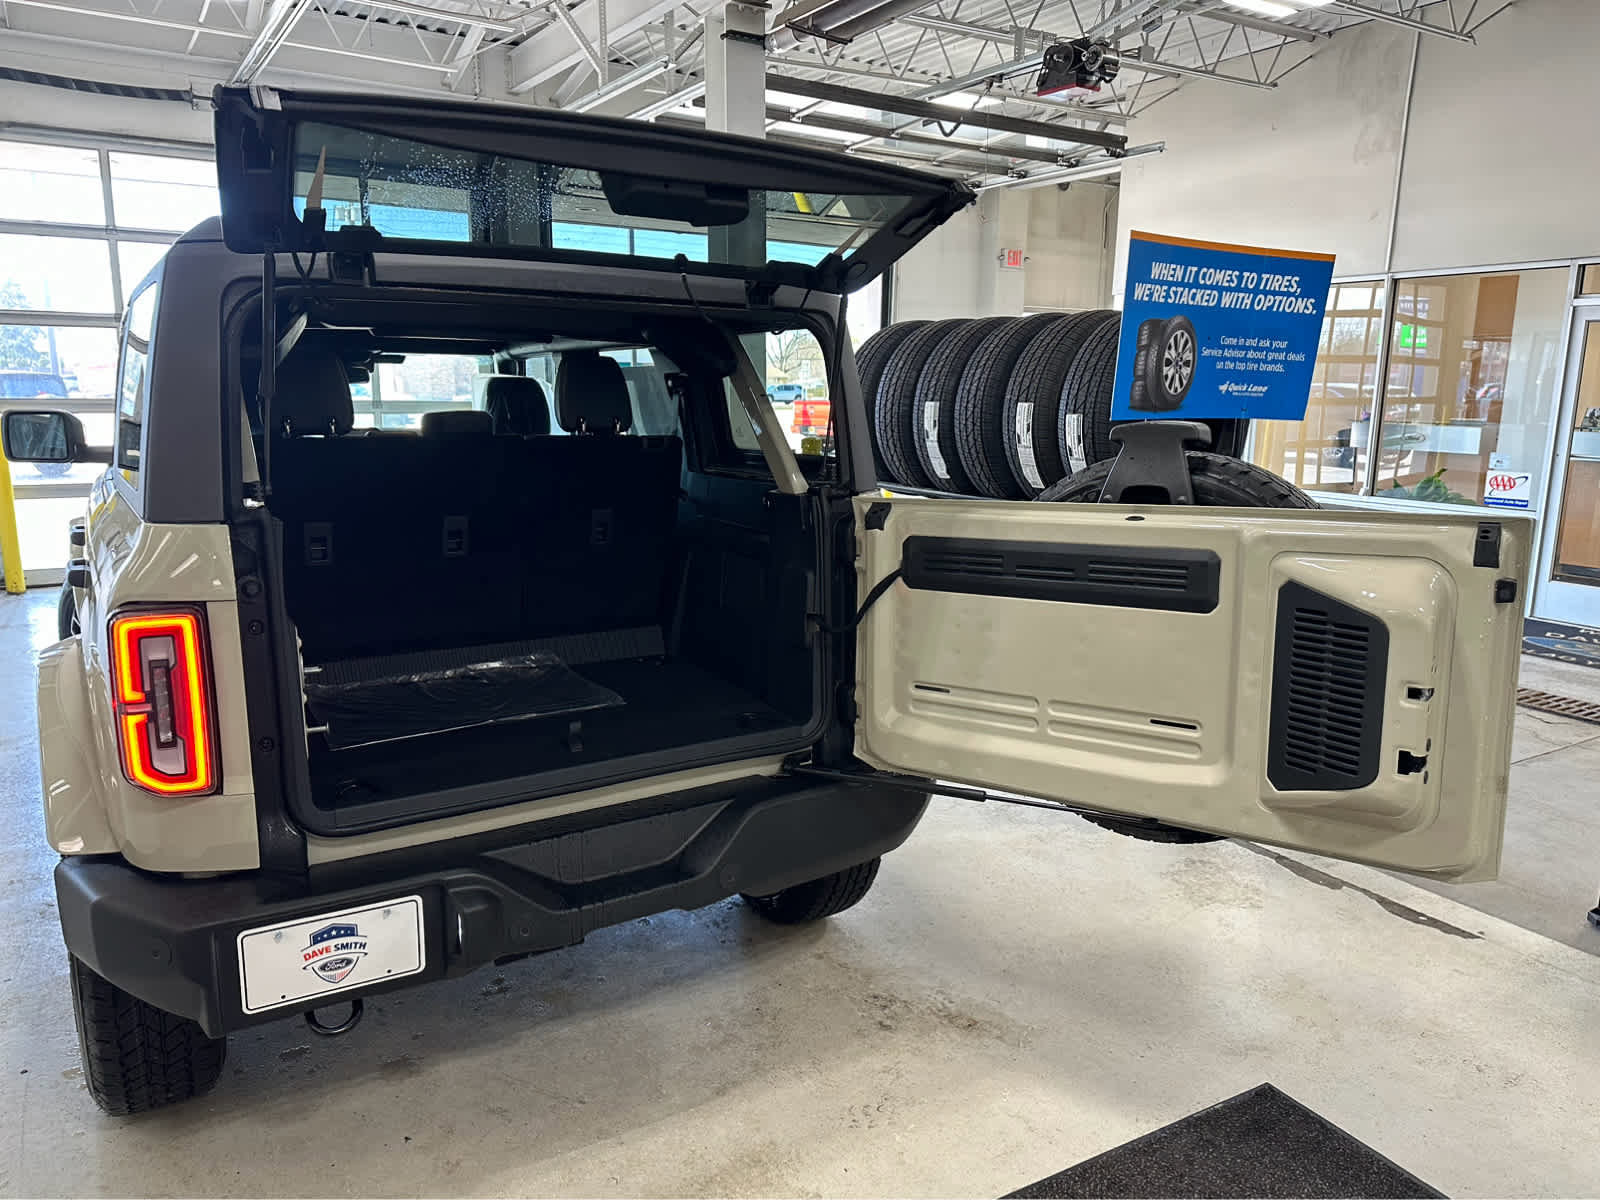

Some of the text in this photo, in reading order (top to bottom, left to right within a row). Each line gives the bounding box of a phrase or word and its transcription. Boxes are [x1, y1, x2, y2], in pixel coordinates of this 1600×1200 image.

[1151, 262, 1302, 295] WHEN IT COMES TO TIRES,
[1134, 283, 1317, 315] WE'RE STACKED WITH OPTIONS.
[1220, 336, 1288, 350] Come in and ask your
[1201, 347, 1305, 361] Service Advisor about great deals
[1216, 360, 1285, 373] on the top tire brands.
[1228, 382, 1269, 393] Quick Lane
[1490, 475, 1516, 491] AAA
[303, 942, 367, 961] DAVE SMITH
[324, 959, 348, 971] Ford
